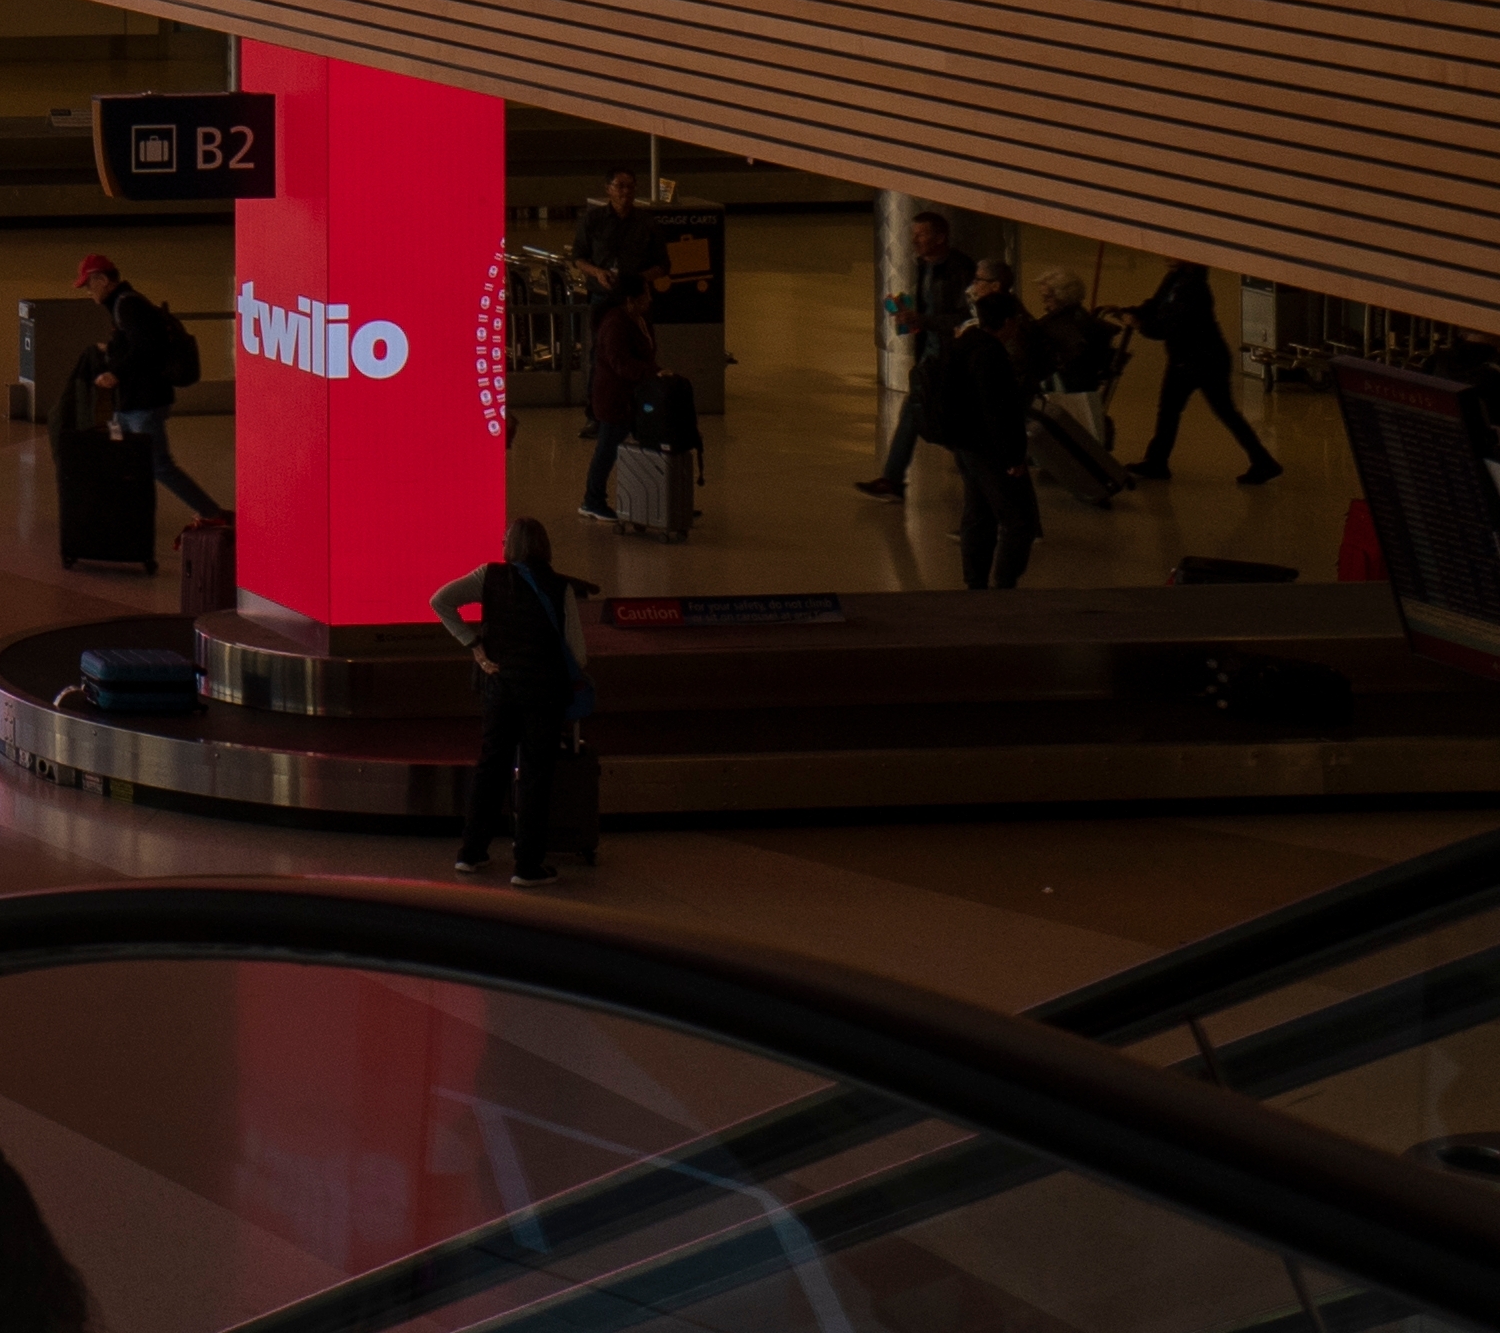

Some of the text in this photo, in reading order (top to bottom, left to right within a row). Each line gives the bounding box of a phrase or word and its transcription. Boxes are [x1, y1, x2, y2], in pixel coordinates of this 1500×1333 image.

[196, 126, 255, 171] B2
[653, 215, 718, 225] GGAGE CARTS
[238, 281, 408, 379] twilio
[1363, 380, 1433, 408] Arrivals
[617, 605, 679, 621] Caution
[688, 602, 704, 612] For
[707, 603, 730, 614] your
[769, 600, 782, 610] do
[785, 600, 802, 610] not
[805, 598, 832, 609] climb
